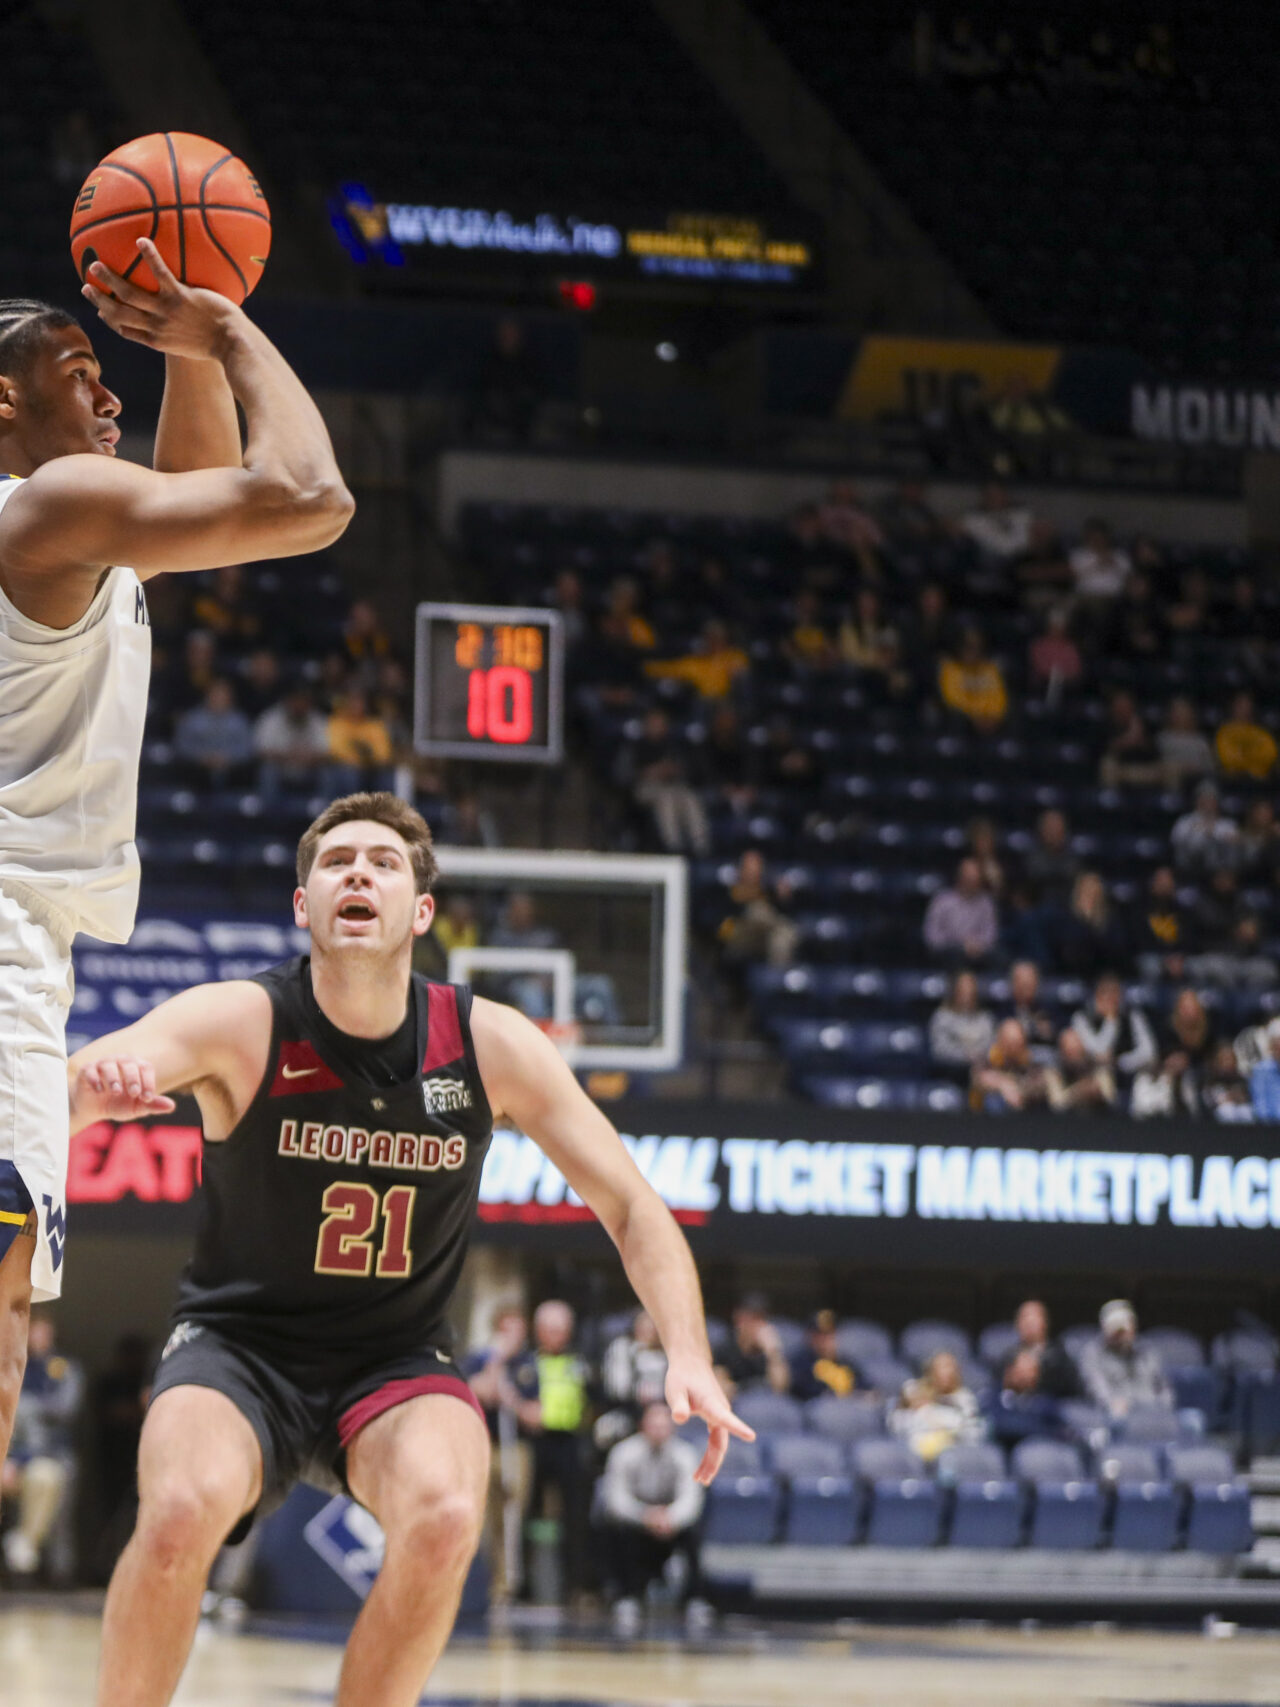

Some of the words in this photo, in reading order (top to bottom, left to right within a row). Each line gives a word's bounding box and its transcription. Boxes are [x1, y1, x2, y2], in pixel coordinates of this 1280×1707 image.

[467, 665, 533, 743] 10
[278, 1119, 466, 1172] LEOPARDS
[721, 1138, 916, 1217] TICKET
[314, 1181, 416, 1278] 21
